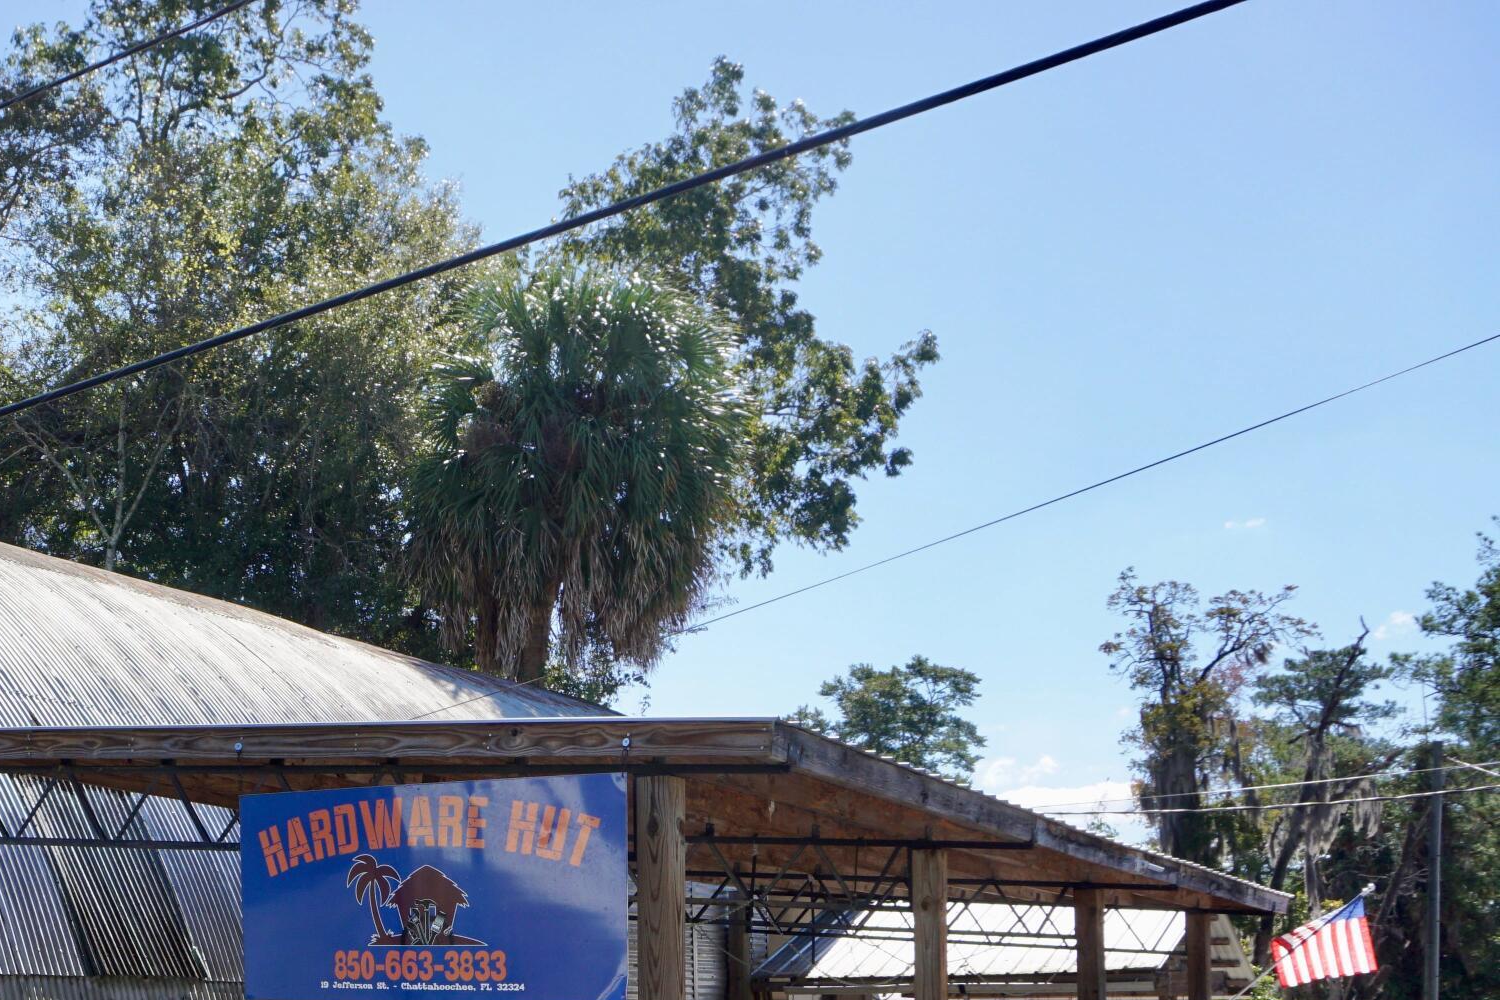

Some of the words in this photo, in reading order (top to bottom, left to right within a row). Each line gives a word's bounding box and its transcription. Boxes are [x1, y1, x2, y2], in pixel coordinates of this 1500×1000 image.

[258, 796, 489, 877] HARDWARE
[505, 800, 601, 867] HUT
[334, 949, 508, 982] 850-663-3833
[320, 981, 329, 989] 19
[332, 981, 373, 990] Jefferson
[376, 981, 390, 990] St.
[400, 982, 476, 991] Chattahoochee,
[480, 983, 493, 991] FL
[497, 983, 525, 991] 32324
